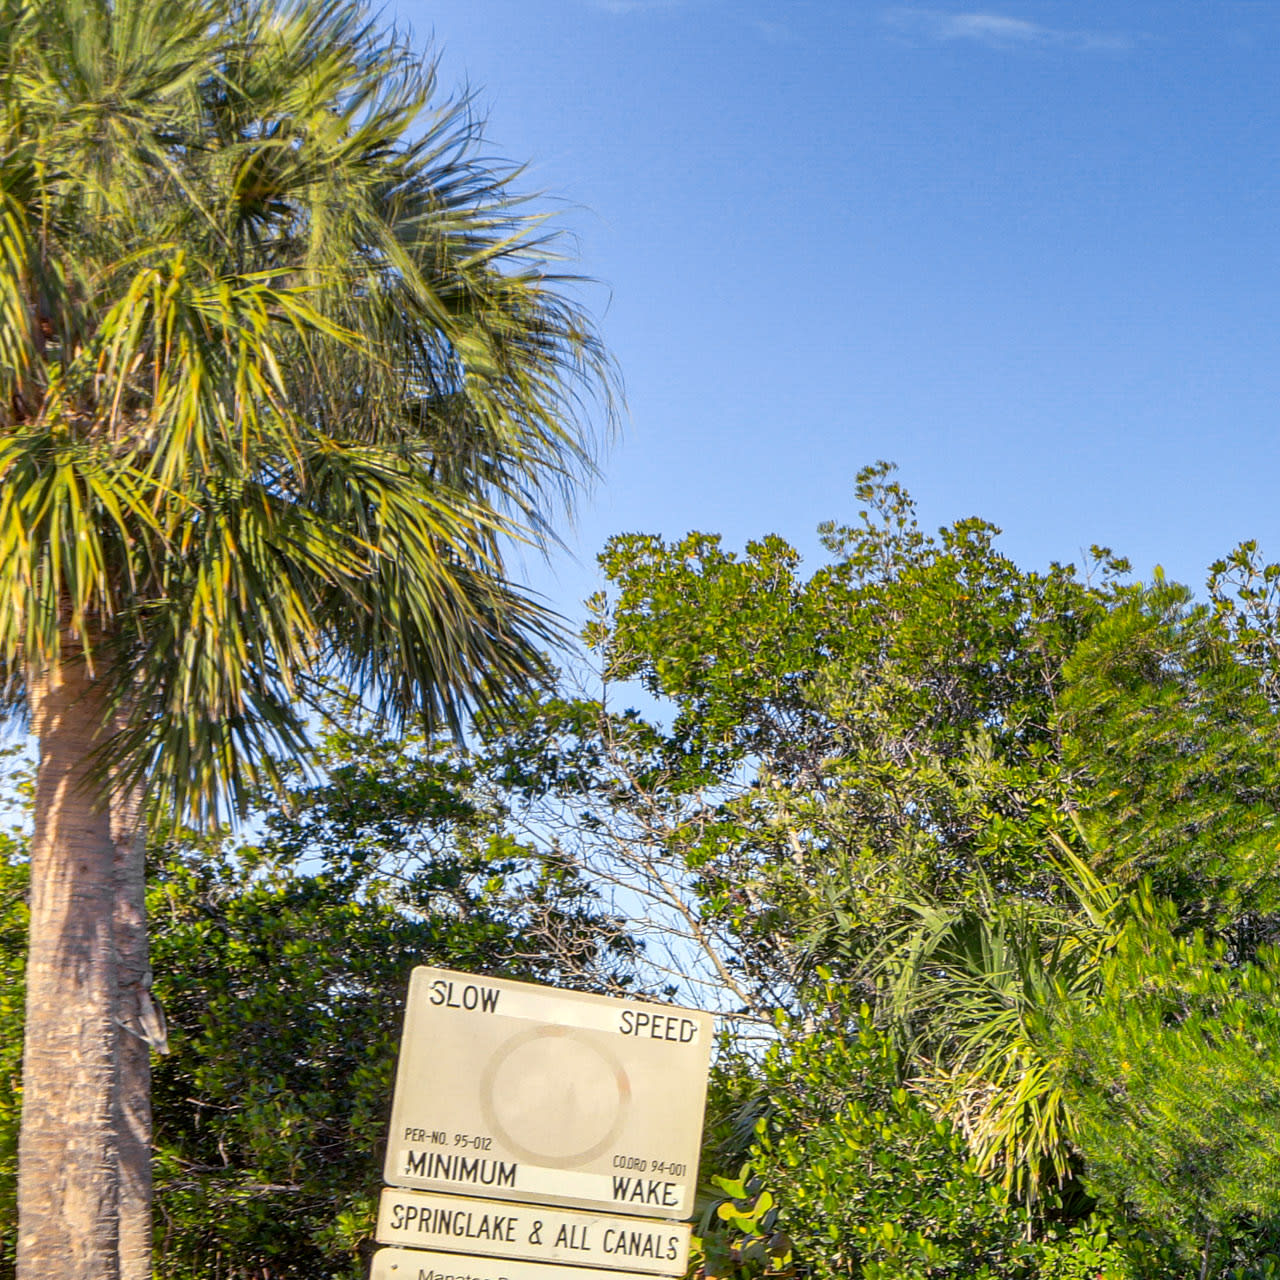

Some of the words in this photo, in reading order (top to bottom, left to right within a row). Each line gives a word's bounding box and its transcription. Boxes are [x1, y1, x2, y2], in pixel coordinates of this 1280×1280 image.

[429, 980, 500, 1014] SLOW
[619, 1010, 695, 1043] SPEED
[404, 1127, 449, 1146] PER-NO.
[454, 1134, 492, 1151] 95-012
[405, 1150, 517, 1187] MINIMUM
[613, 1176, 678, 1206] WAKE
[651, 1160, 686, 1177] 94-001
[390, 1204, 518, 1242] SPRINGLAKE
[528, 1220, 544, 1246] &
[554, 1224, 591, 1251] ALL
[603, 1229, 679, 1261] CANALS
